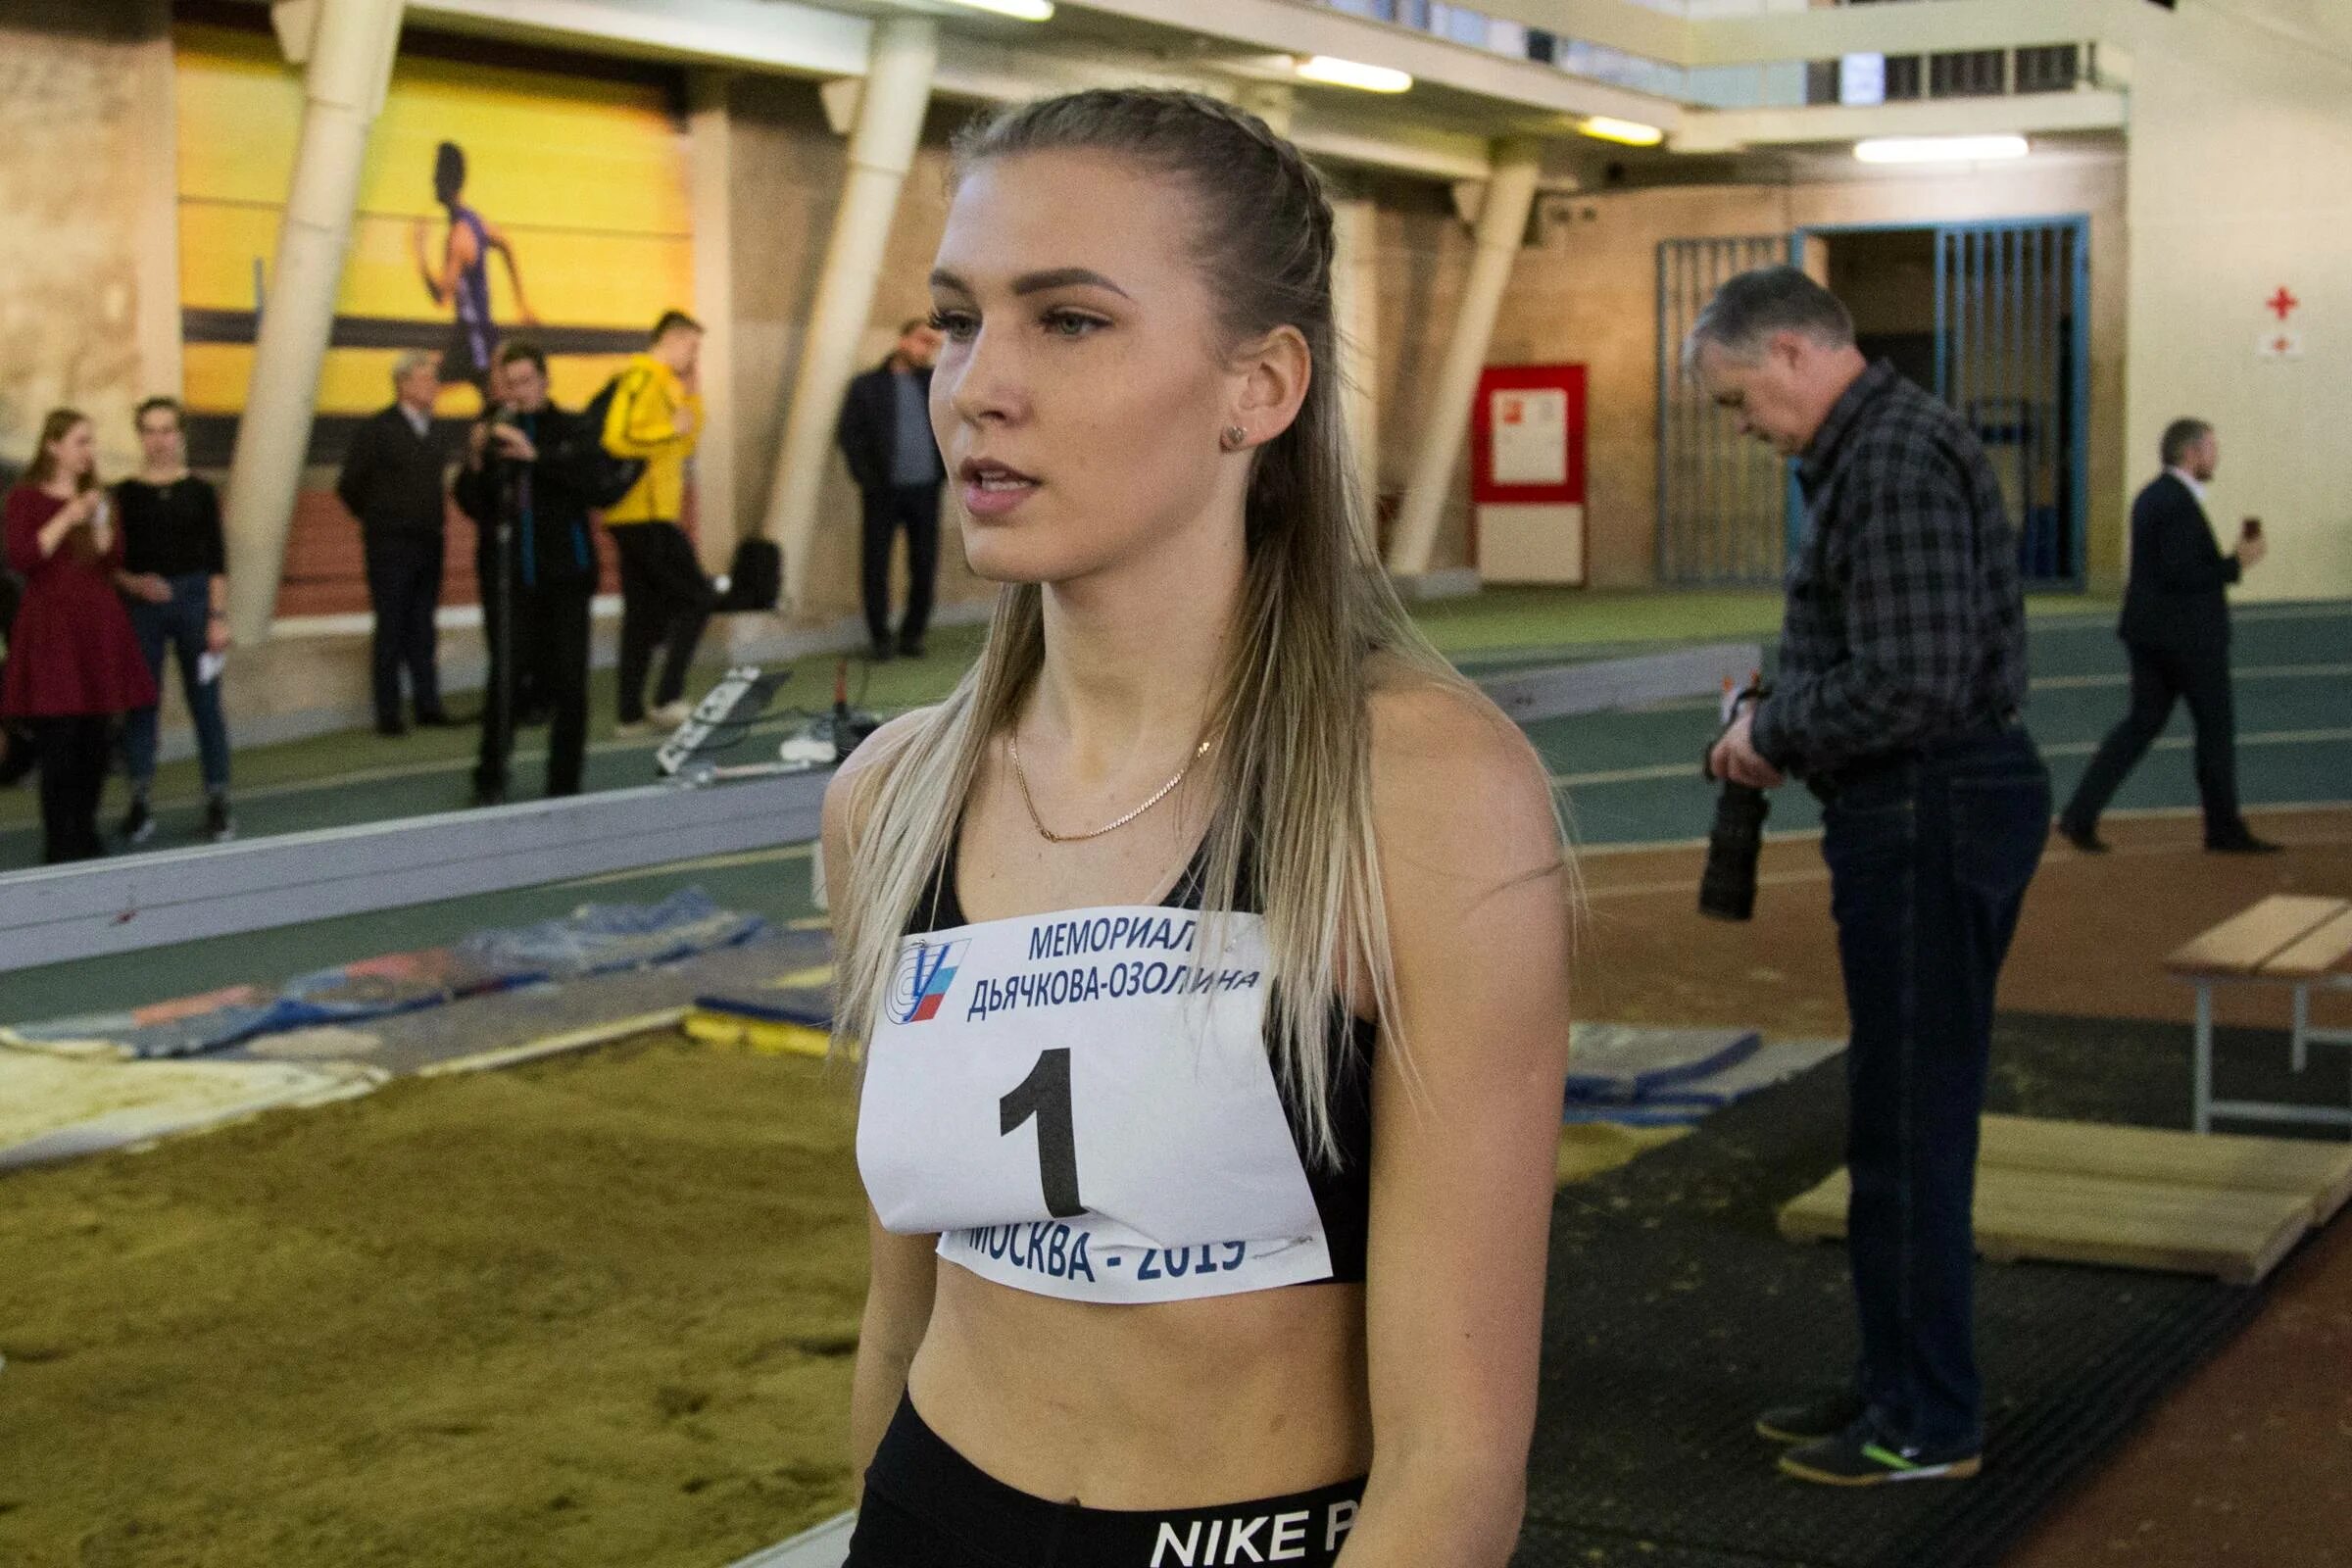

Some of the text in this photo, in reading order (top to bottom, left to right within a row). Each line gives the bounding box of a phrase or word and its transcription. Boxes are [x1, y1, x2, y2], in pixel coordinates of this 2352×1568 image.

[1029, 916, 1196, 960] МЕМОРИАЛ
[967, 960, 1260, 1022] ДЬЯЧКОВА-ОЗОЛИНА
[999, 1047, 1090, 1218] 1
[1150, 1509, 1310, 1568] NIKE
